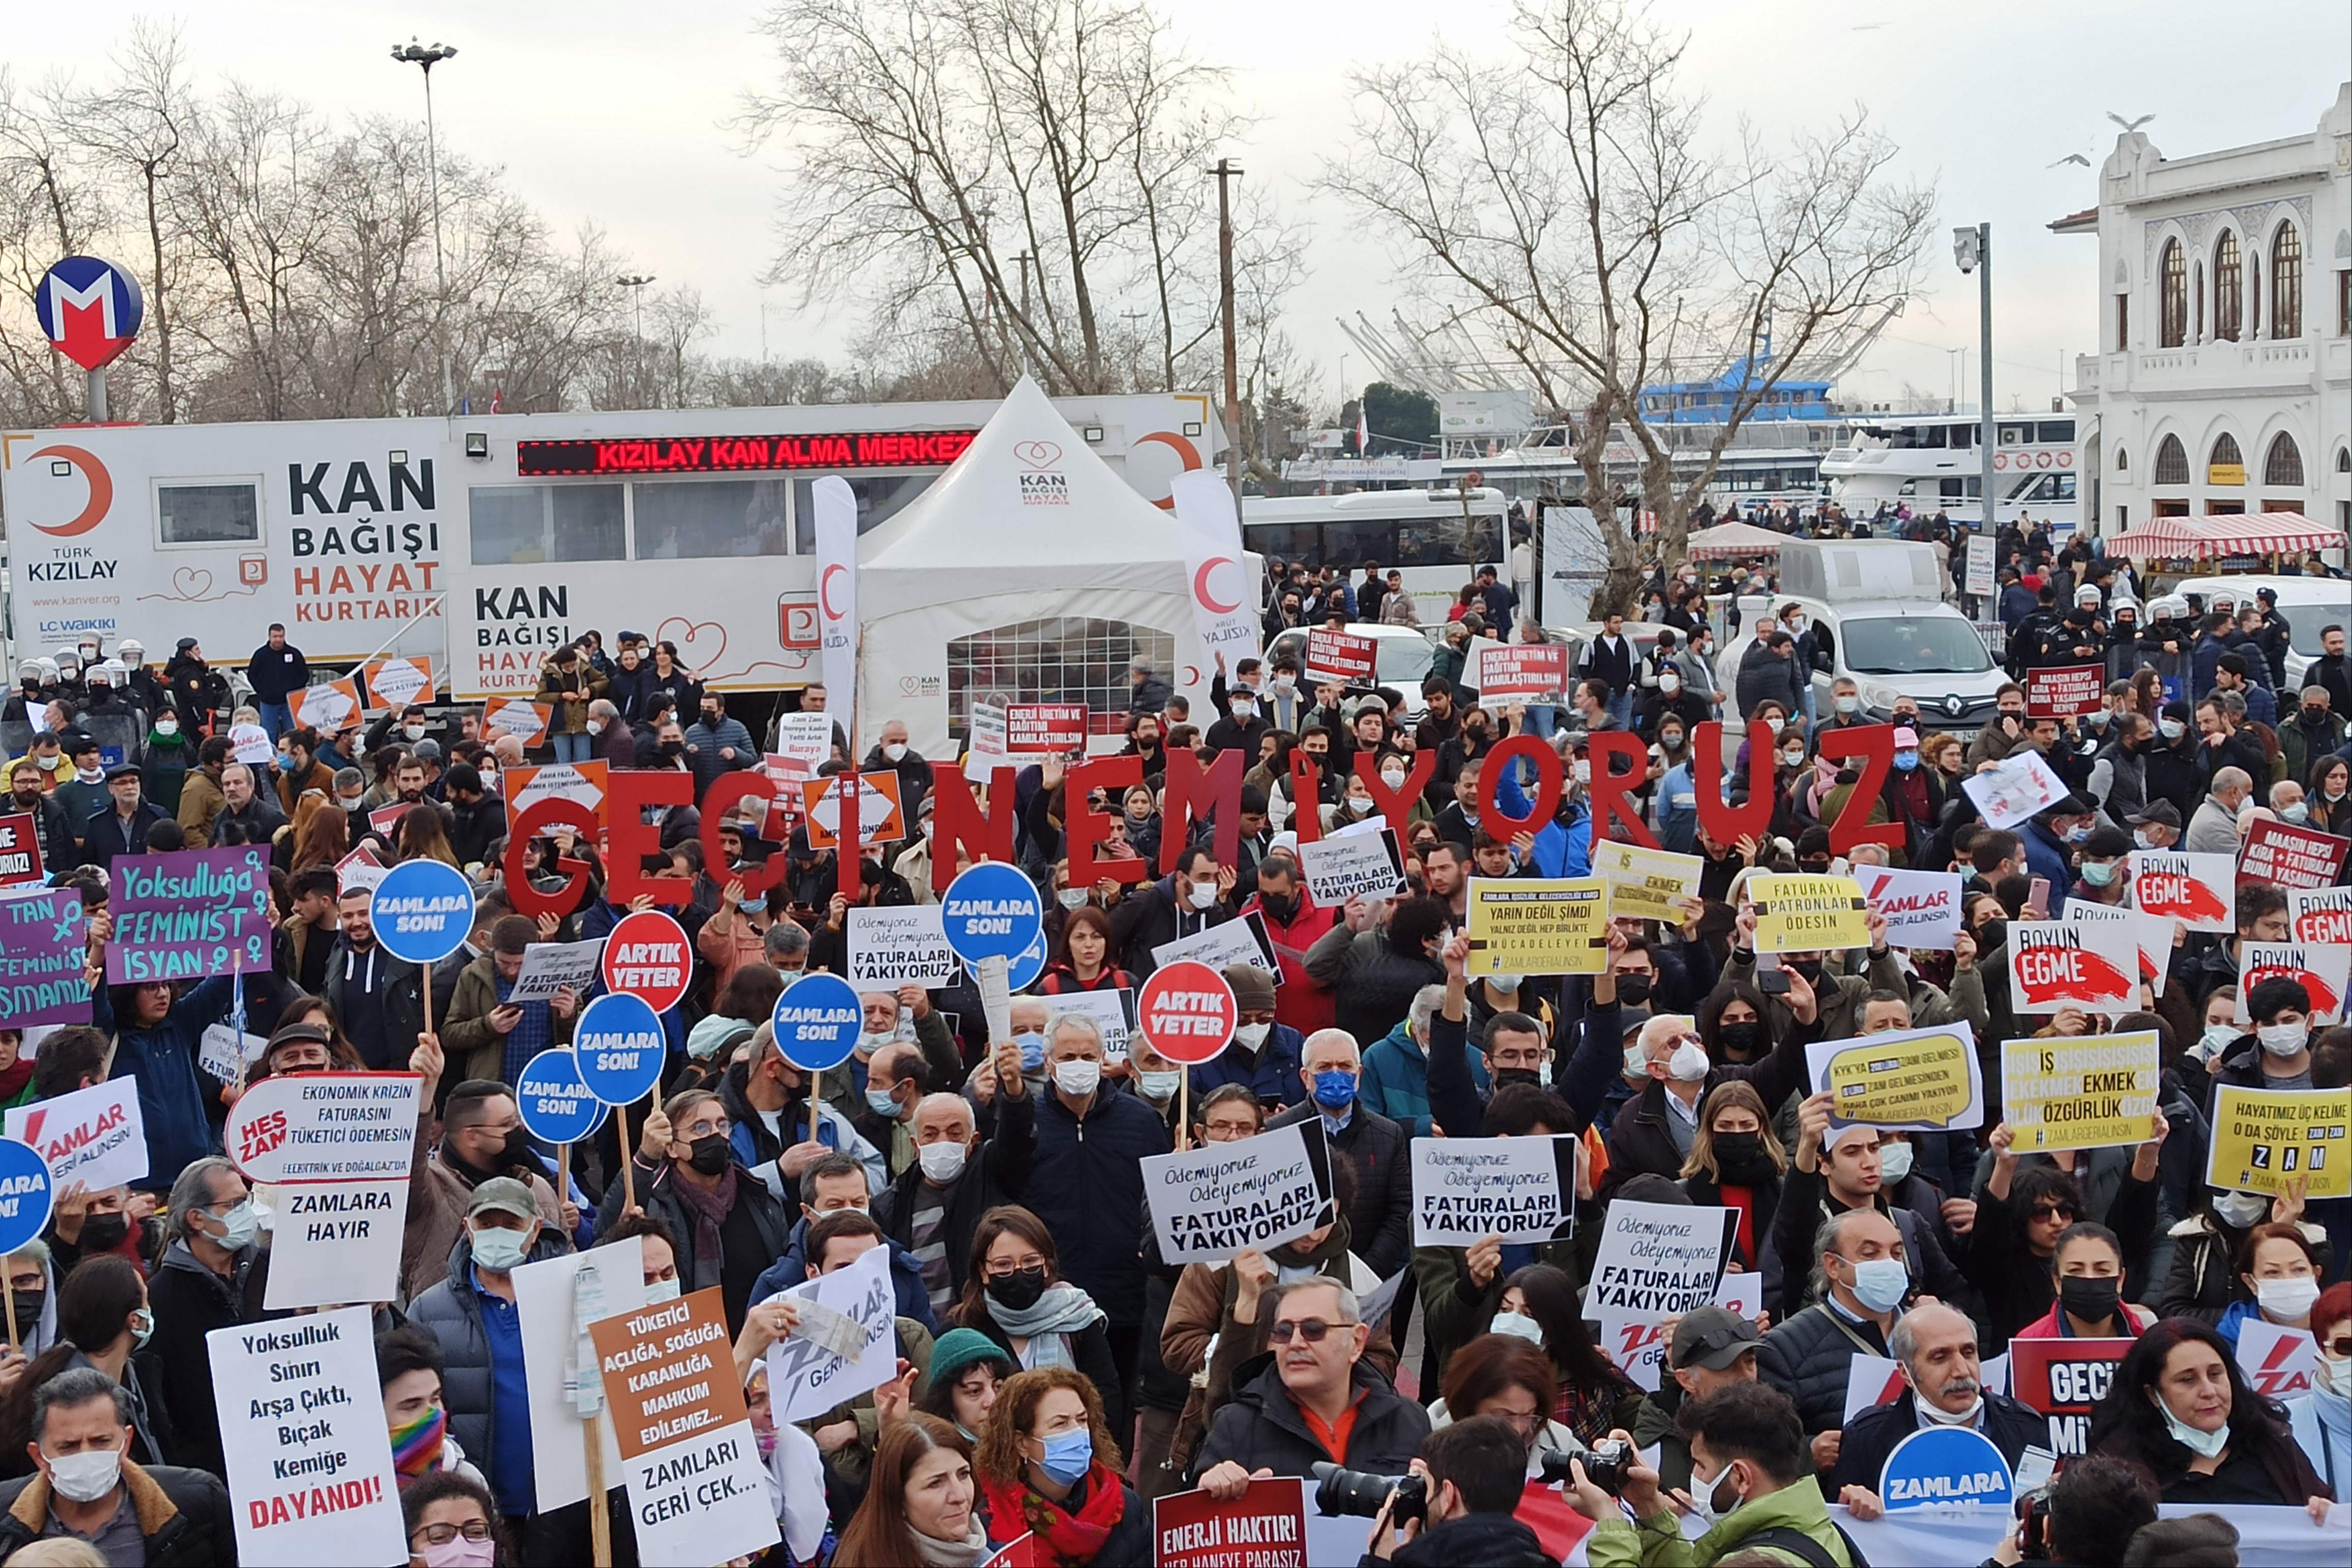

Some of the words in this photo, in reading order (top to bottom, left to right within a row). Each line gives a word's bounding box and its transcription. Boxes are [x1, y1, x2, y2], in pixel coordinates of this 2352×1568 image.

[599, 441, 704, 468] KIZILAY
[712, 440, 769, 466] KAN
[775, 438, 853, 465] ALMA
[289, 458, 437, 515] KAN
[1020, 475, 1066, 486] KAN
[1021, 486, 1068, 495] BAĞIŞI
[292, 518, 438, 559] BAĞIŞI
[53, 545, 93, 558] TÜRK
[28, 560, 117, 581] KIZILAY
[294, 561, 439, 595] HAYAT
[33, 595, 120, 606] www.kanver.org
[296, 599, 442, 623] KURTARIR
[476, 585, 568, 620] KAN
[40, 621, 57, 632] LC
[477, 622, 569, 649] BAĞIŞI
[1361, 640, 1371, 651] VE
[1483, 649, 1510, 663] ENERJİ
[1512, 648, 1545, 661] ÜRETİM
[1547, 649, 1559, 663] VE
[1010, 707, 1037, 720] ENERJİ
[1039, 707, 1069, 720] ÜRETİM
[1070, 708, 1081, 721] VE
[789, 745, 821, 755] Buraya
[2248, 843, 2274, 862] KİRA
[1312, 865, 1393, 888] FATURALARI
[2141, 856, 2190, 877] BOYUN
[122, 863, 252, 908] Yoksulluğa
[1313, 876, 1396, 899] YAKIYORUZ
[1645, 875, 1683, 894] EKMEK
[1774, 882, 1841, 897] FATURAYI
[2141, 876, 2192, 905] EĞME
[375, 894, 468, 915] ZAMLARA
[947, 899, 1034, 916] ZAMLARA
[1490, 907, 1523, 921] YARIN
[1525, 904, 1556, 920] DEĞİL
[1559, 903, 1591, 921] ŞİMDİ
[1770, 897, 1848, 912] PATRONLAR
[114, 907, 248, 944] FEMİNİST
[396, 915, 445, 933] SON!
[857, 914, 918, 933] Ödemiyoruz
[965, 918, 1012, 935] SON!
[1786, 913, 1837, 930] ÖDESİN
[1906, 909, 1951, 924] ALINSIN
[1490, 925, 1515, 934] YALNIZ
[1517, 924, 1538, 934] DEĞİL
[1540, 924, 1554, 933] HEP
[1556, 922, 1589, 933] BİRLİKTE
[2019, 926, 2080, 952] BOYUN
[124, 948, 203, 980] İSYAN
[615, 943, 681, 964] ARTIK
[856, 950, 950, 964] FATURALARI
[2252, 950, 2306, 970] BOYUN
[523, 969, 593, 984] FATURALARI
[612, 967, 681, 988] YETER
[854, 963, 950, 980] YAKIYORUZ
[2021, 948, 2087, 986] EĞME
[1152, 991, 1225, 1013] ARTIK
[779, 1007, 857, 1024] ZAMLARA
[1150, 1014, 1223, 1037] YETER
[580, 1031, 659, 1051] ZAMLARA
[796, 1025, 838, 1042] SON!
[597, 1052, 639, 1071] SON!
[1901, 1055, 1920, 1067] ZAM
[2040, 1048, 2054, 1075] İŞ
[303, 1084, 370, 1100] EKONOMİK
[372, 1083, 413, 1100] KRİZİN
[1867, 1081, 1886, 1093] ZAM
[1888, 1070, 1949, 1088] GELMESİNDEN
[2083, 1071, 2136, 1094] EKMEK
[537, 1100, 576, 1115] SON!
[1869, 1097, 1887, 1109] ÇOK
[1888, 1092, 1920, 1104] CANIMI
[1922, 1084, 1958, 1099] YAKIYOR
[318, 1107, 391, 1122] FATURASINI
[2043, 1096, 2122, 1123] ÖZGÜRLÜK
[2236, 1102, 2297, 1120] HAYATIMIZ
[2298, 1104, 2312, 1122] ÜÇ
[2313, 1101, 2347, 1119] KELİME
[241, 1110, 287, 1142] HES
[291, 1127, 346, 1144] TÜKETİCİ
[349, 1127, 412, 1143] ÖDEMESİN
[2233, 1122, 2242, 1136] O
[2244, 1122, 2261, 1139] DA
[2308, 1127, 2325, 1139] ZAM
[2329, 1126, 2344, 1138] ZAM
[239, 1128, 287, 1164] ZAM
[332, 1163, 343, 1173] VE
[1165, 1155, 1259, 1185] Ödemiyoruz
[1425, 1147, 1510, 1172] Ödemiyoruz
[1190, 1161, 1304, 1205] Ödeyemiyoruz
[1444, 1167, 1550, 1194] Ödeyemiyoruz
[290, 1192, 392, 1214] ZAMLARA
[1170, 1182, 1313, 1232] FATURALARI
[1424, 1195, 1556, 1213] FATURALARI
[307, 1221, 370, 1241] HAYIR
[1170, 1200, 1316, 1251] YAKIYORUZ
[1422, 1211, 1556, 1233] YAKIYORUZ
[1616, 1212, 1692, 1243] Ödemiyoruz
[1630, 1236, 1717, 1267] Ödeyemiyoruz
[1602, 1266, 1715, 1290] FATURALARI
[626, 1301, 690, 1337] TÜKETİCİ
[243, 1322, 340, 1355] Yoksulluk
[604, 1343, 662, 1374] AÇLIĞA,
[665, 1322, 725, 1355] SOĞUĞA
[270, 1360, 320, 1383] Sınırı
[628, 1352, 713, 1394] KARANLIĞA
[250, 1395, 294, 1419] Arşa
[301, 1385, 352, 1415] Çıktı,
[641, 1381, 710, 1417] MAHKUM
[278, 1419, 333, 1447] Bıçak
[639, 1410, 723, 1446] EDİLEMEZ...
[273, 1451, 347, 1480] Kemiğe
[641, 1438, 740, 1491] ZAMLARI
[1890, 1471, 2006, 1500] ZAMLARA
[249, 1475, 384, 1530] DAYANDI!
[640, 1490, 691, 1526] GERİ
[696, 1474, 757, 1512] ÇEK...
[1163, 1515, 1221, 1555] ENERJİ
[1226, 1515, 1297, 1544] HAKTIR!
[1246, 1550, 1301, 1568] PARASIZ
